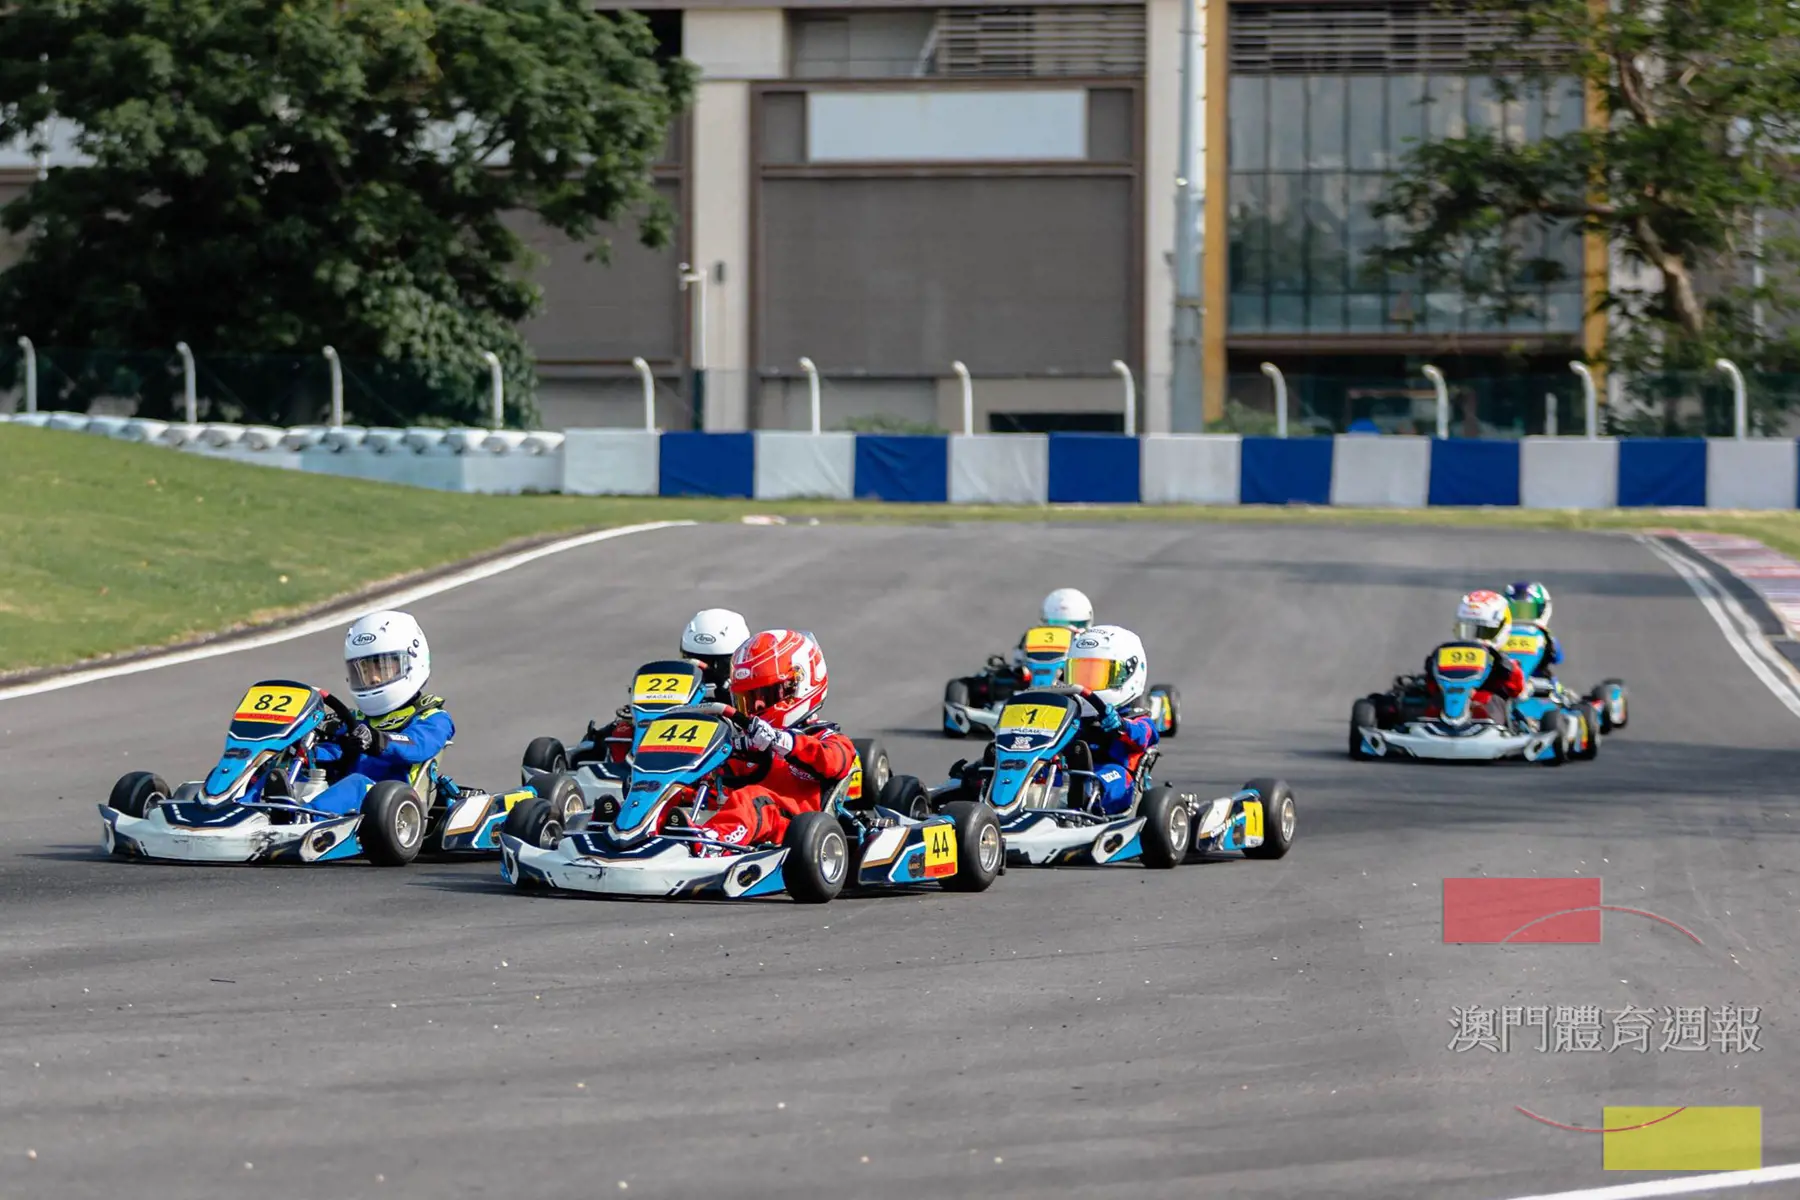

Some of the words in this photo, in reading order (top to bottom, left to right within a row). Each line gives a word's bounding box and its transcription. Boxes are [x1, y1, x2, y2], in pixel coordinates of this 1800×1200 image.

[1044, 632, 1054, 643] 3
[1451, 651, 1476, 663] 99
[646, 678, 679, 692] 22
[254, 694, 293, 712] 82
[1026, 708, 1038, 724] 1
[658, 724, 699, 742] 44
[1253, 809, 1258, 832] 1
[933, 831, 949, 858] 44
